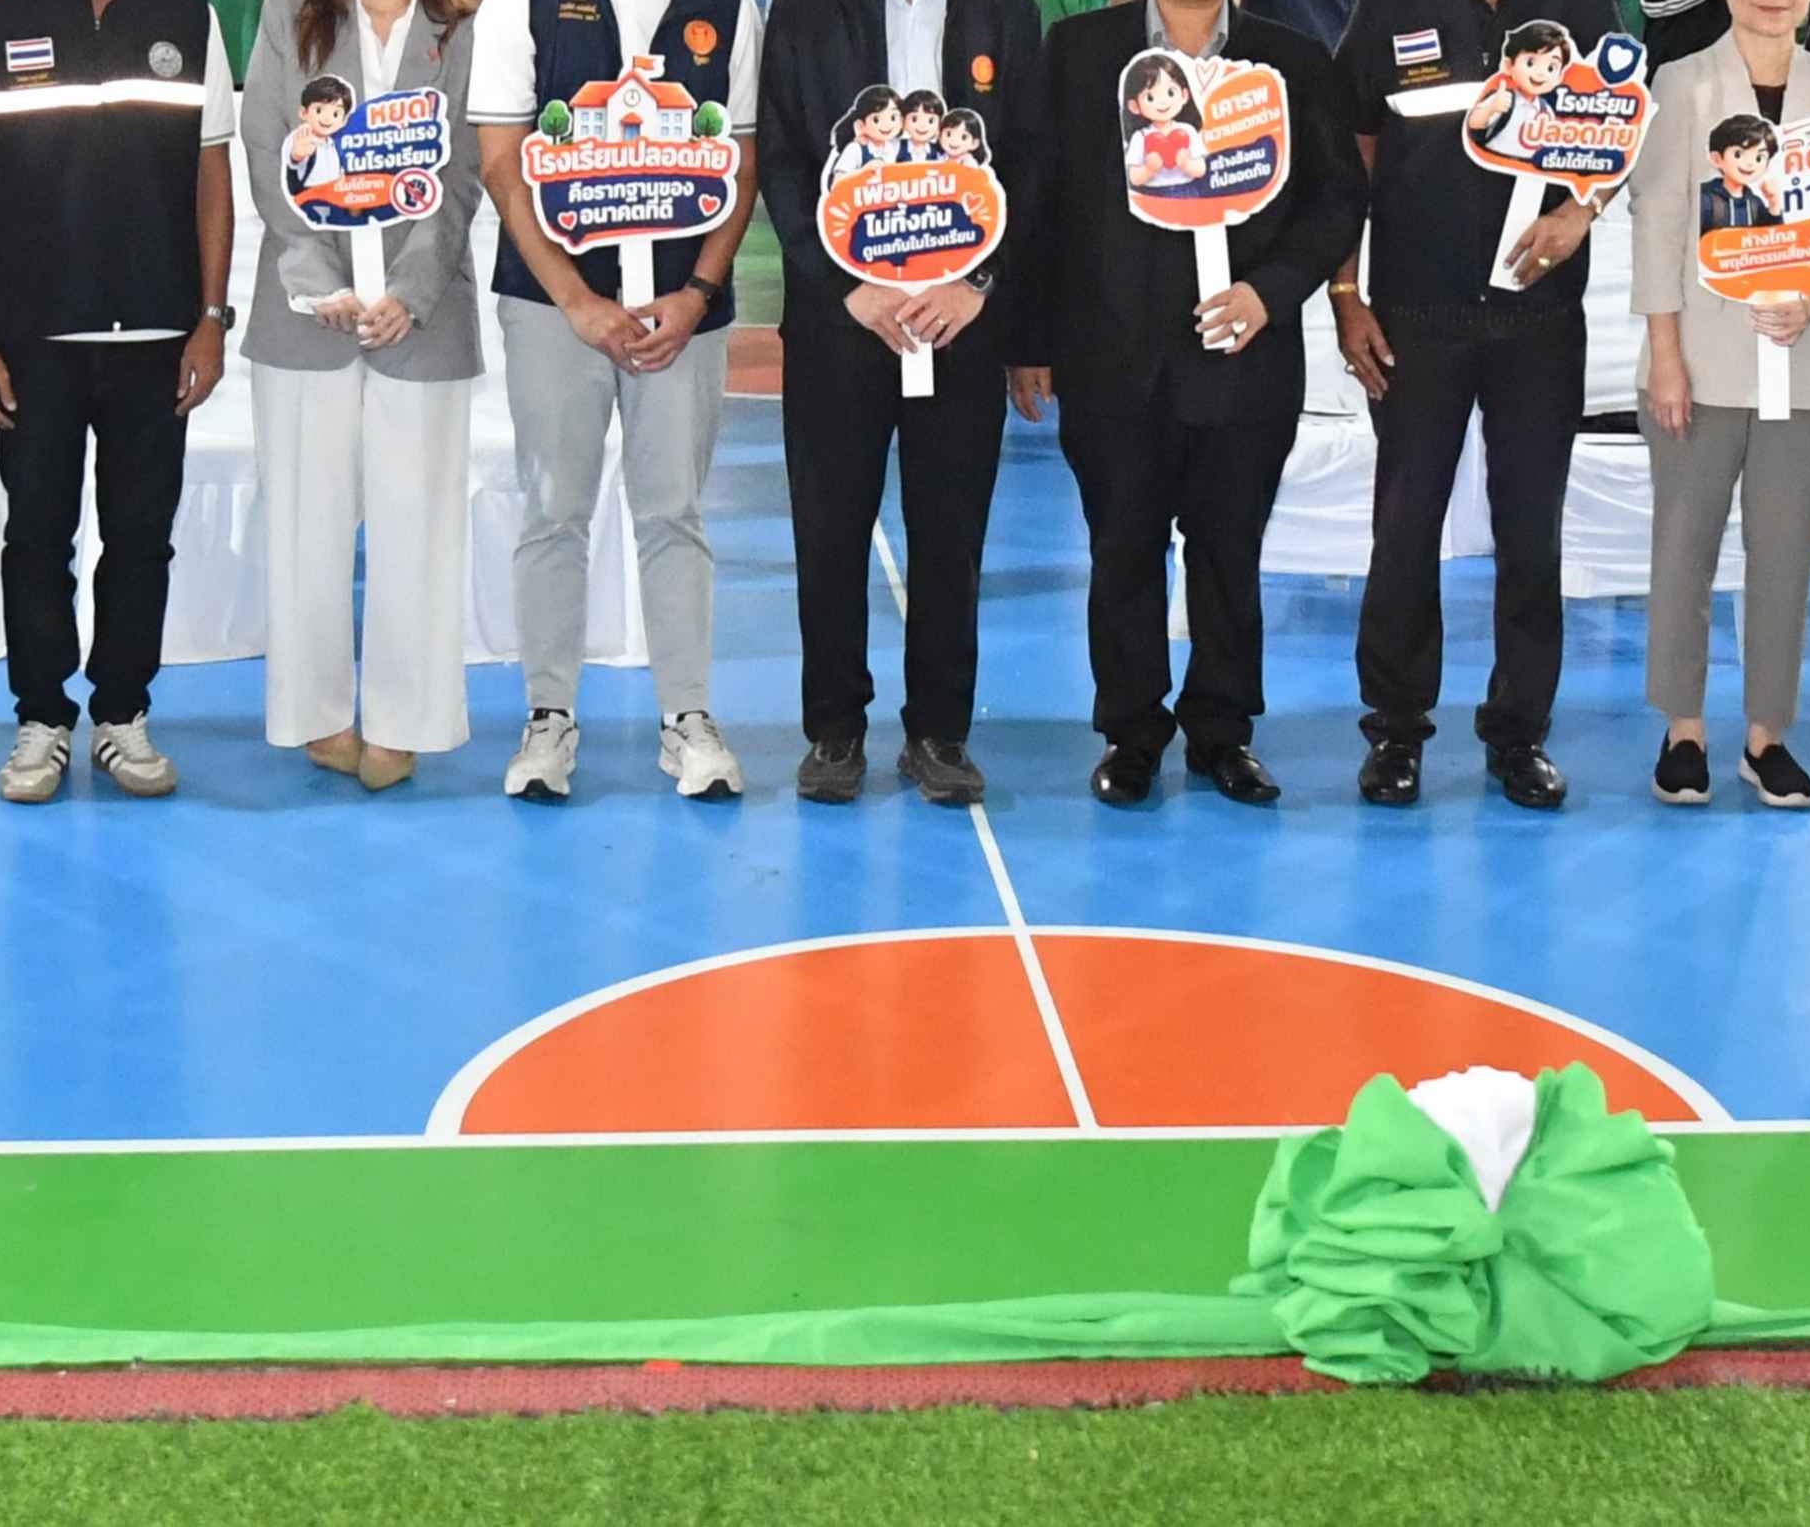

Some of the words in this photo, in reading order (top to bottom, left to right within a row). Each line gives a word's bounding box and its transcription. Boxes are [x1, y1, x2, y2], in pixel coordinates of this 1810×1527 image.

[368, 93, 439, 129] หยุด!
[1556, 87, 1637, 115] โรงเรียน
[340, 125, 438, 150] ความรุนแรง
[1524, 115, 1636, 149] ปลอดภัย
[345, 146, 438, 172] ในโรงเรียน
[528, 140, 729, 175] โรงเรียนปลอดภัย
[1541, 149, 1614, 171] เริ่มได้ที่เรา
[568, 179, 695, 203] คือรากฐานของ
[853, 167, 957, 207] เพื่อนกัน
[580, 196, 674, 224] อนาคตที่ดี
[863, 202, 953, 238] ไม่ทิ้งกัน
[861, 228, 977, 263] ดูแลกันในโรงเรียน
